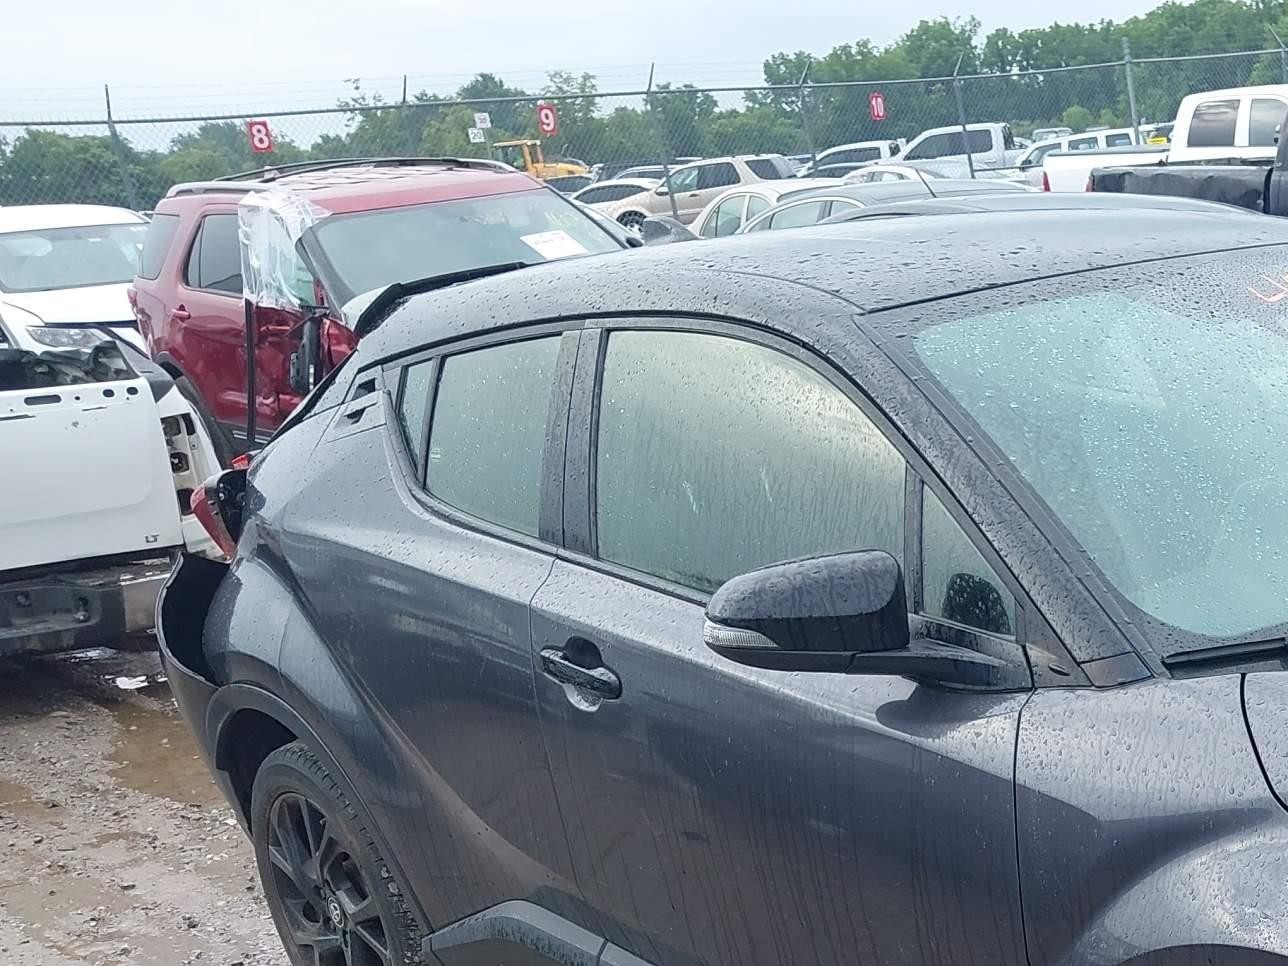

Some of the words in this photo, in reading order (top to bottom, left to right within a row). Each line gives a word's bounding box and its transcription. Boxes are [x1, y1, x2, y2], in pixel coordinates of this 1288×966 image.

[871, 97, 884, 117] 10
[540, 108, 555, 131] 9
[252, 124, 270, 149] 8
[145, 534, 160, 544] LT
